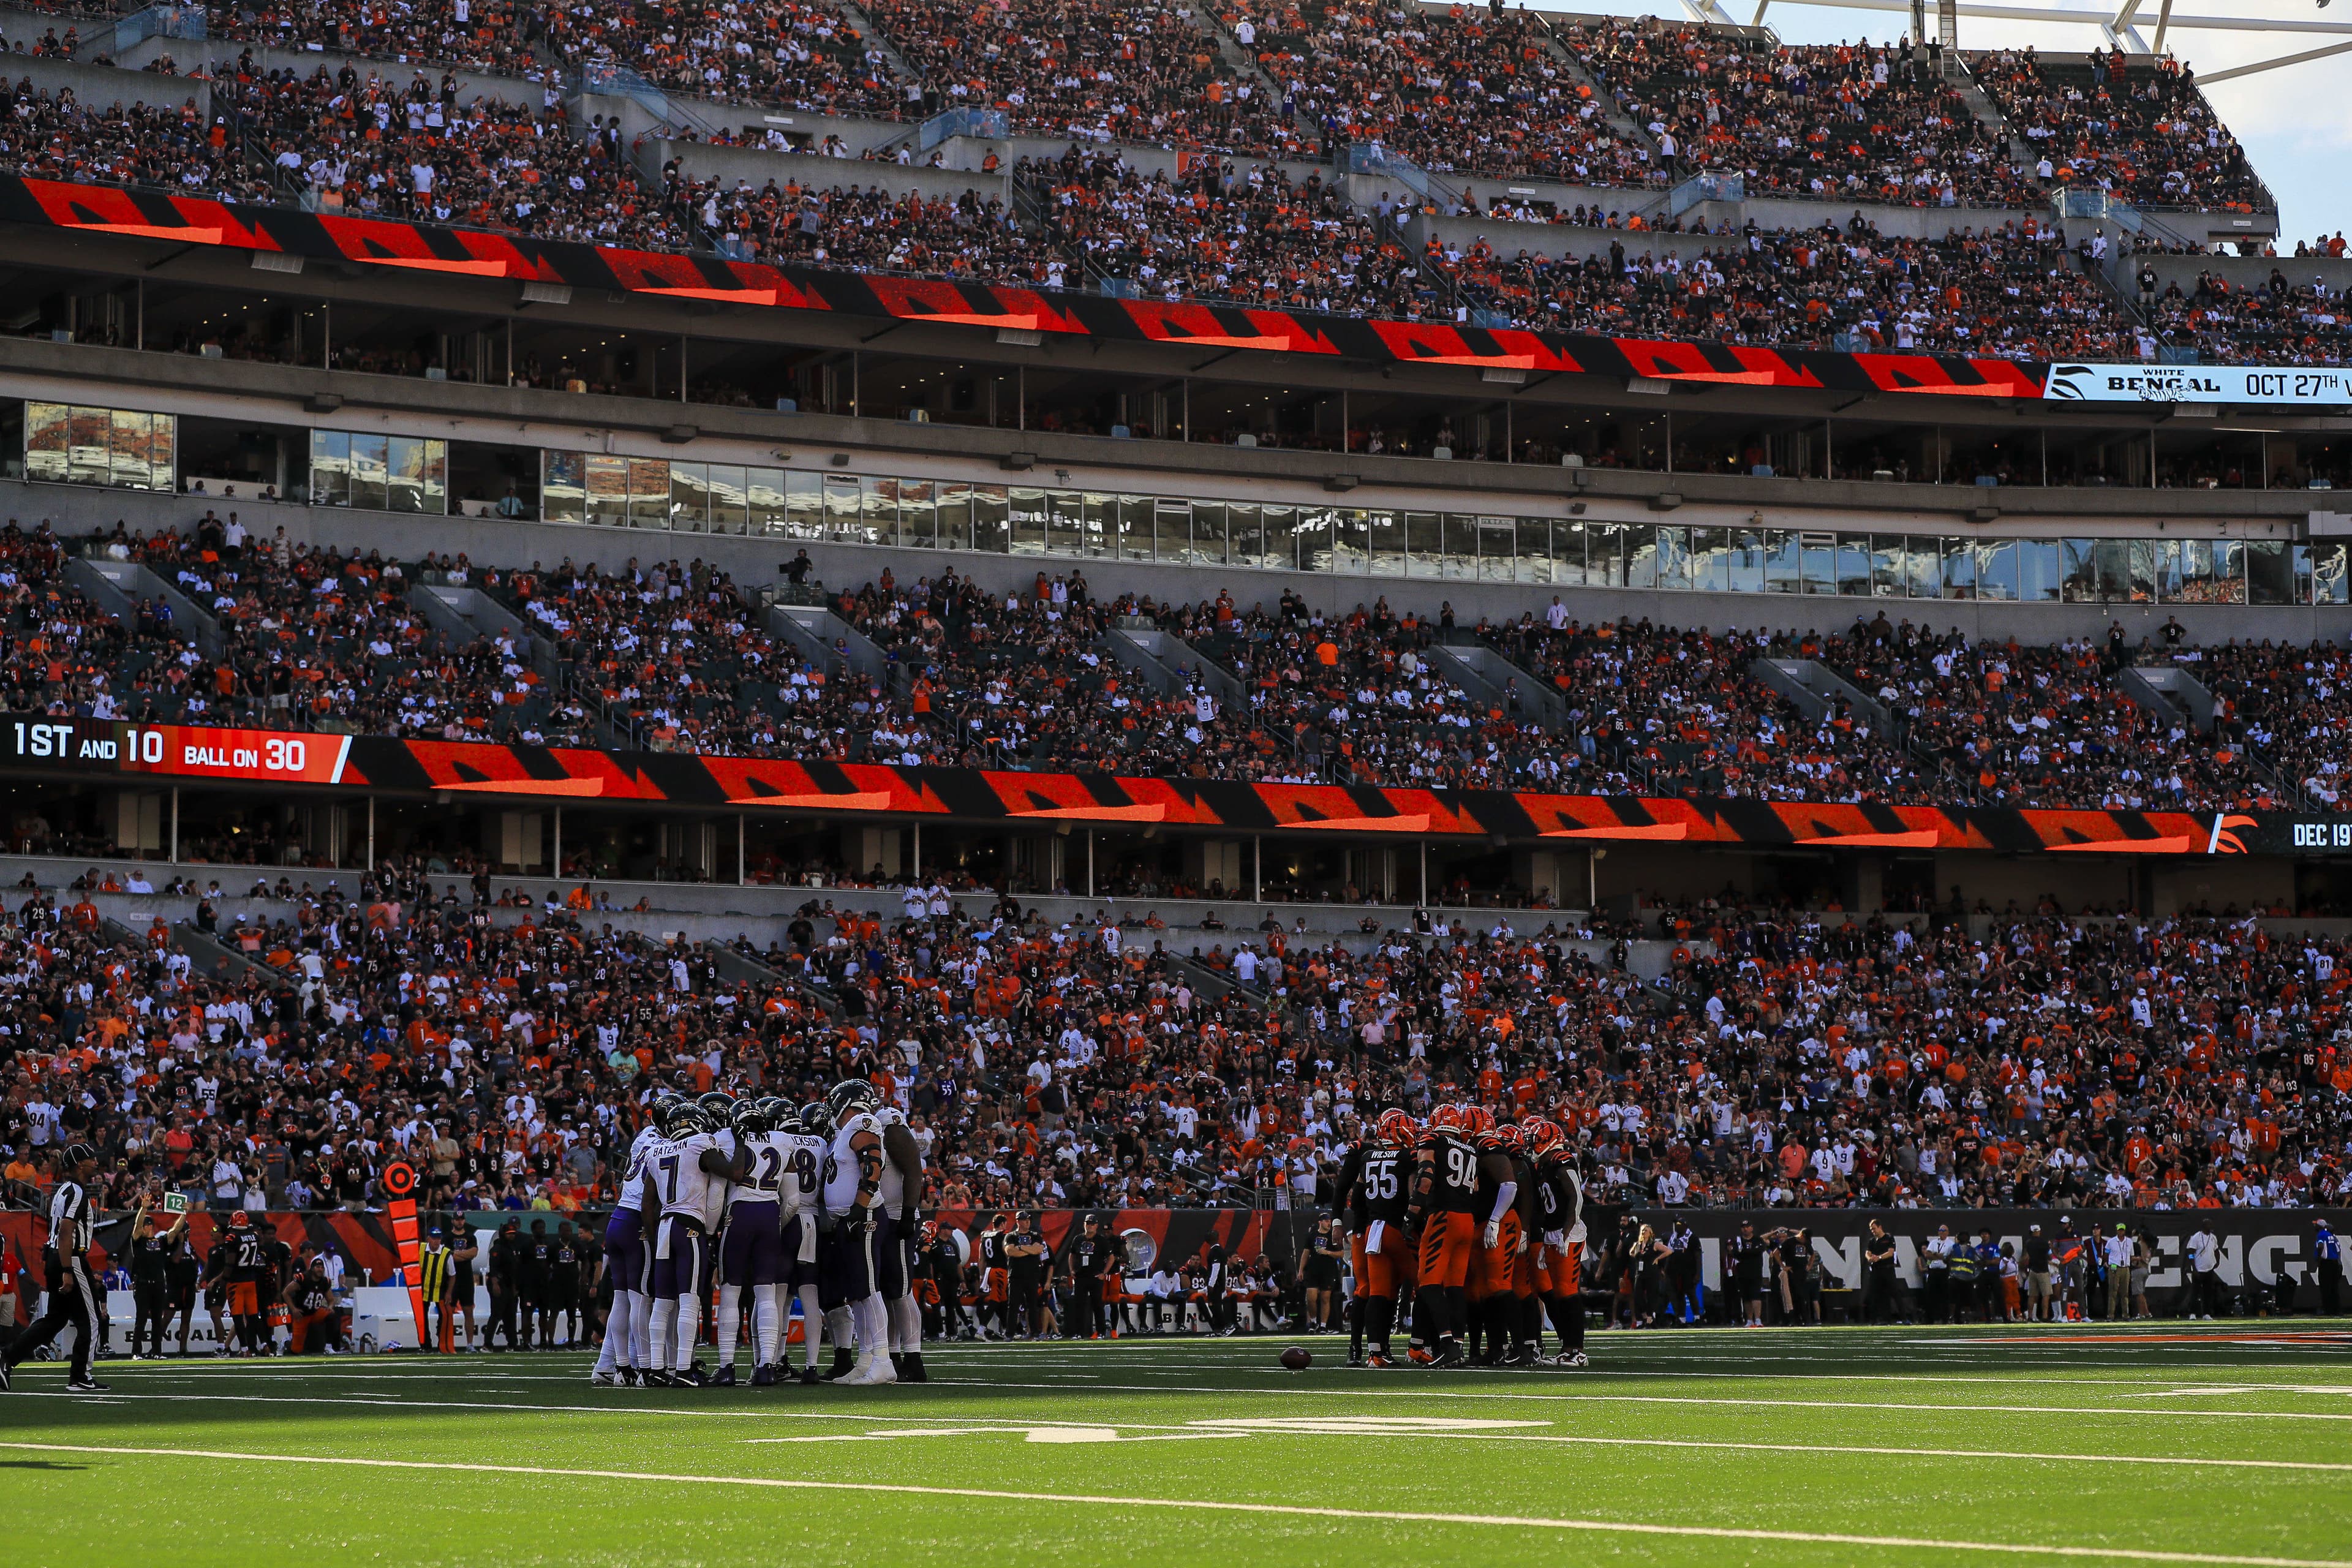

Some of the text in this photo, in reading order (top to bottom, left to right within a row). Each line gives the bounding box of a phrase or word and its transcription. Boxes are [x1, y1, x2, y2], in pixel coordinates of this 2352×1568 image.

[785, 18, 790, 27] 9
[1373, 274, 1377, 283] 9
[2107, 377, 2220, 393] BENGAL
[2247, 374, 2288, 396] OCT
[2295, 375, 2338, 396] 27TH
[1202, 701, 1208, 710] 9
[398, 708, 404, 717] 9
[15, 722, 163, 763] 1ST AND 10
[184, 739, 306, 771] BALL ON 30
[2005, 749, 2010, 758] 9
[2294, 824, 2352, 847] DEC 19
[385, 874, 391, 885] 9
[1422, 911, 1427, 921] 9
[158, 933, 162, 942] 9
[1108, 932, 1113, 941] 9
[553, 962, 559, 973] 9
[709, 967, 714, 978] 9
[1031, 967, 1037, 978] 9
[1804, 966, 1809, 975] 9
[969, 970, 974, 980] 9
[2046, 972, 2051, 982] 9
[1469, 980, 1474, 989] 9
[1433, 1006, 1438, 1016] 2
[2140, 1004, 2147, 1013] 9
[127, 1014, 132, 1025] 9
[623, 1014, 630, 1025] 7
[1215, 1012, 1222, 1021] 9
[1316, 1015, 1322, 1023] 9
[15, 1023, 21, 1035] 9
[1046, 1025, 1051, 1036] 9
[1651, 1025, 1656, 1034] 8
[1820, 1021, 1825, 1030] 9
[1973, 1028, 1978, 1038] 2
[563, 1033, 569, 1045] 9
[607, 1035, 614, 1046] 9
[1065, 1037, 1070, 1047] 9
[1084, 1048, 1088, 1057] 9
[32, 1063, 39, 1074] 9
[1473, 1058, 1478, 1068] 9
[2323, 1062, 2328, 1072] 9
[1862, 1079, 1868, 1090] 9
[880, 1087, 885, 1097] 9
[1364, 1090, 1371, 1101] 9
[1550, 1096, 1555, 1107] 9
[1183, 1114, 1188, 1123] 2
[1268, 1113, 1274, 1125] 9
[1564, 1109, 1570, 1119] 9
[1610, 1110, 1616, 1123] 9
[2316, 1112, 2321, 1123] 9
[1761, 1126, 1768, 1137] 9
[792, 1136, 820, 1147] CKSON
[2242, 1138, 2248, 1148] 9
[653, 1139, 688, 1157] BATEMAN
[2134, 1147, 2139, 1158] 9
[1371, 1150, 1400, 1159] WILSON
[1840, 1153, 1847, 1163] 9
[470, 1159, 477, 1172] 9
[491, 1159, 497, 1171] 9
[543, 1159, 549, 1169] 9
[736, 1144, 778, 1191] 22
[1821, 1158, 1828, 1169] 9
[796, 1148, 817, 1194] 8
[1446, 1148, 1477, 1194] 94
[413, 1174, 420, 1187] 2
[659, 1154, 680, 1204] 7
[1263, 1177, 1268, 1188] 3
[1365, 1160, 1398, 1199] 55
[1667, 1186, 1676, 1197] 9
[171, 1199, 183, 1209] 12
[984, 1237, 993, 1259] 8
[238, 1242, 258, 1267] 27
